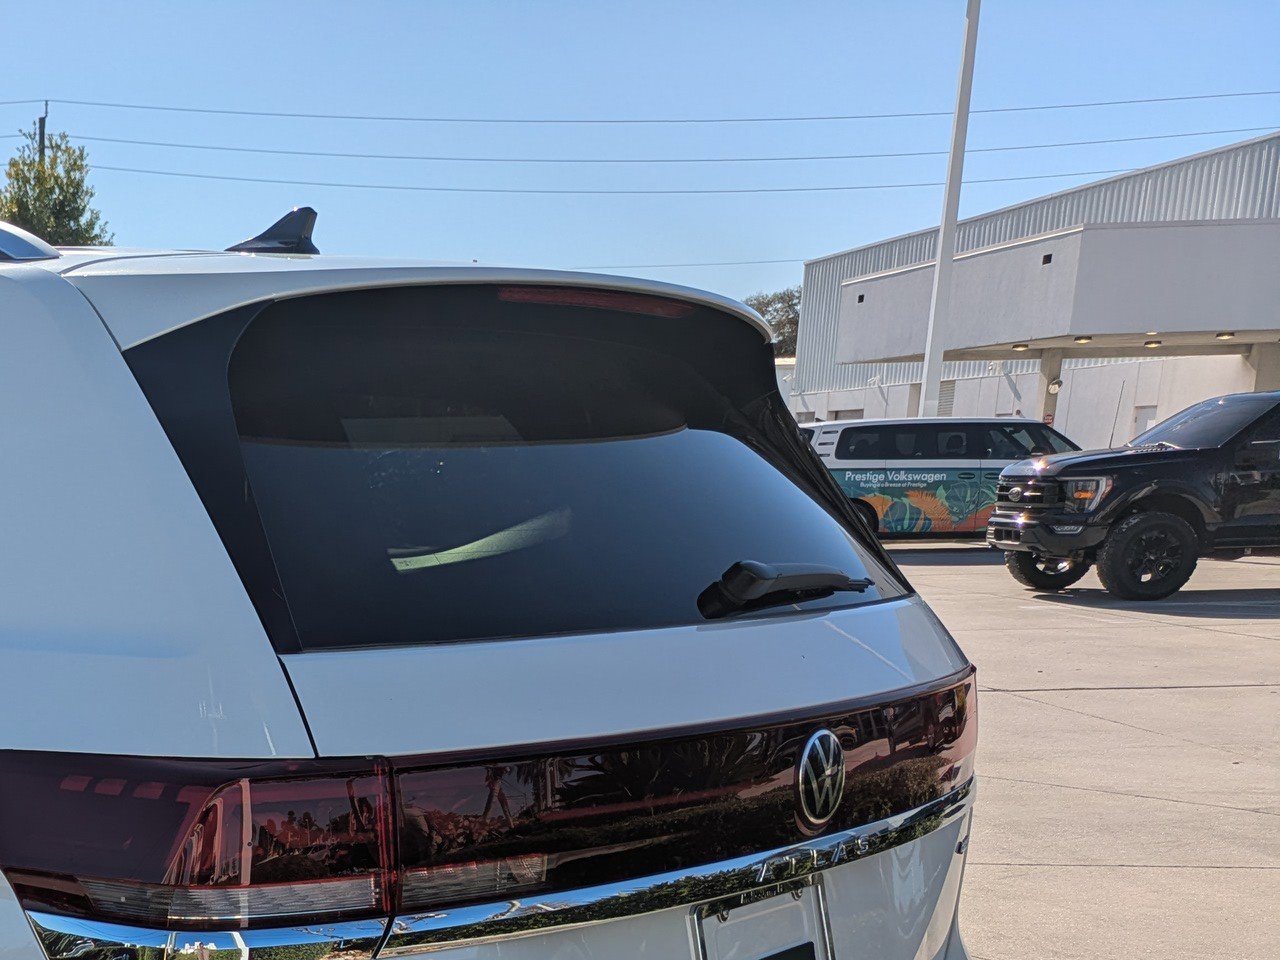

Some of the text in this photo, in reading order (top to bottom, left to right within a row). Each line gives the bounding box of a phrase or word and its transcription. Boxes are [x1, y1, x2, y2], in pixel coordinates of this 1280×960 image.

[845, 470, 947, 483] Prestige Volkswagen
[756, 834, 870, 882] ATLAS
